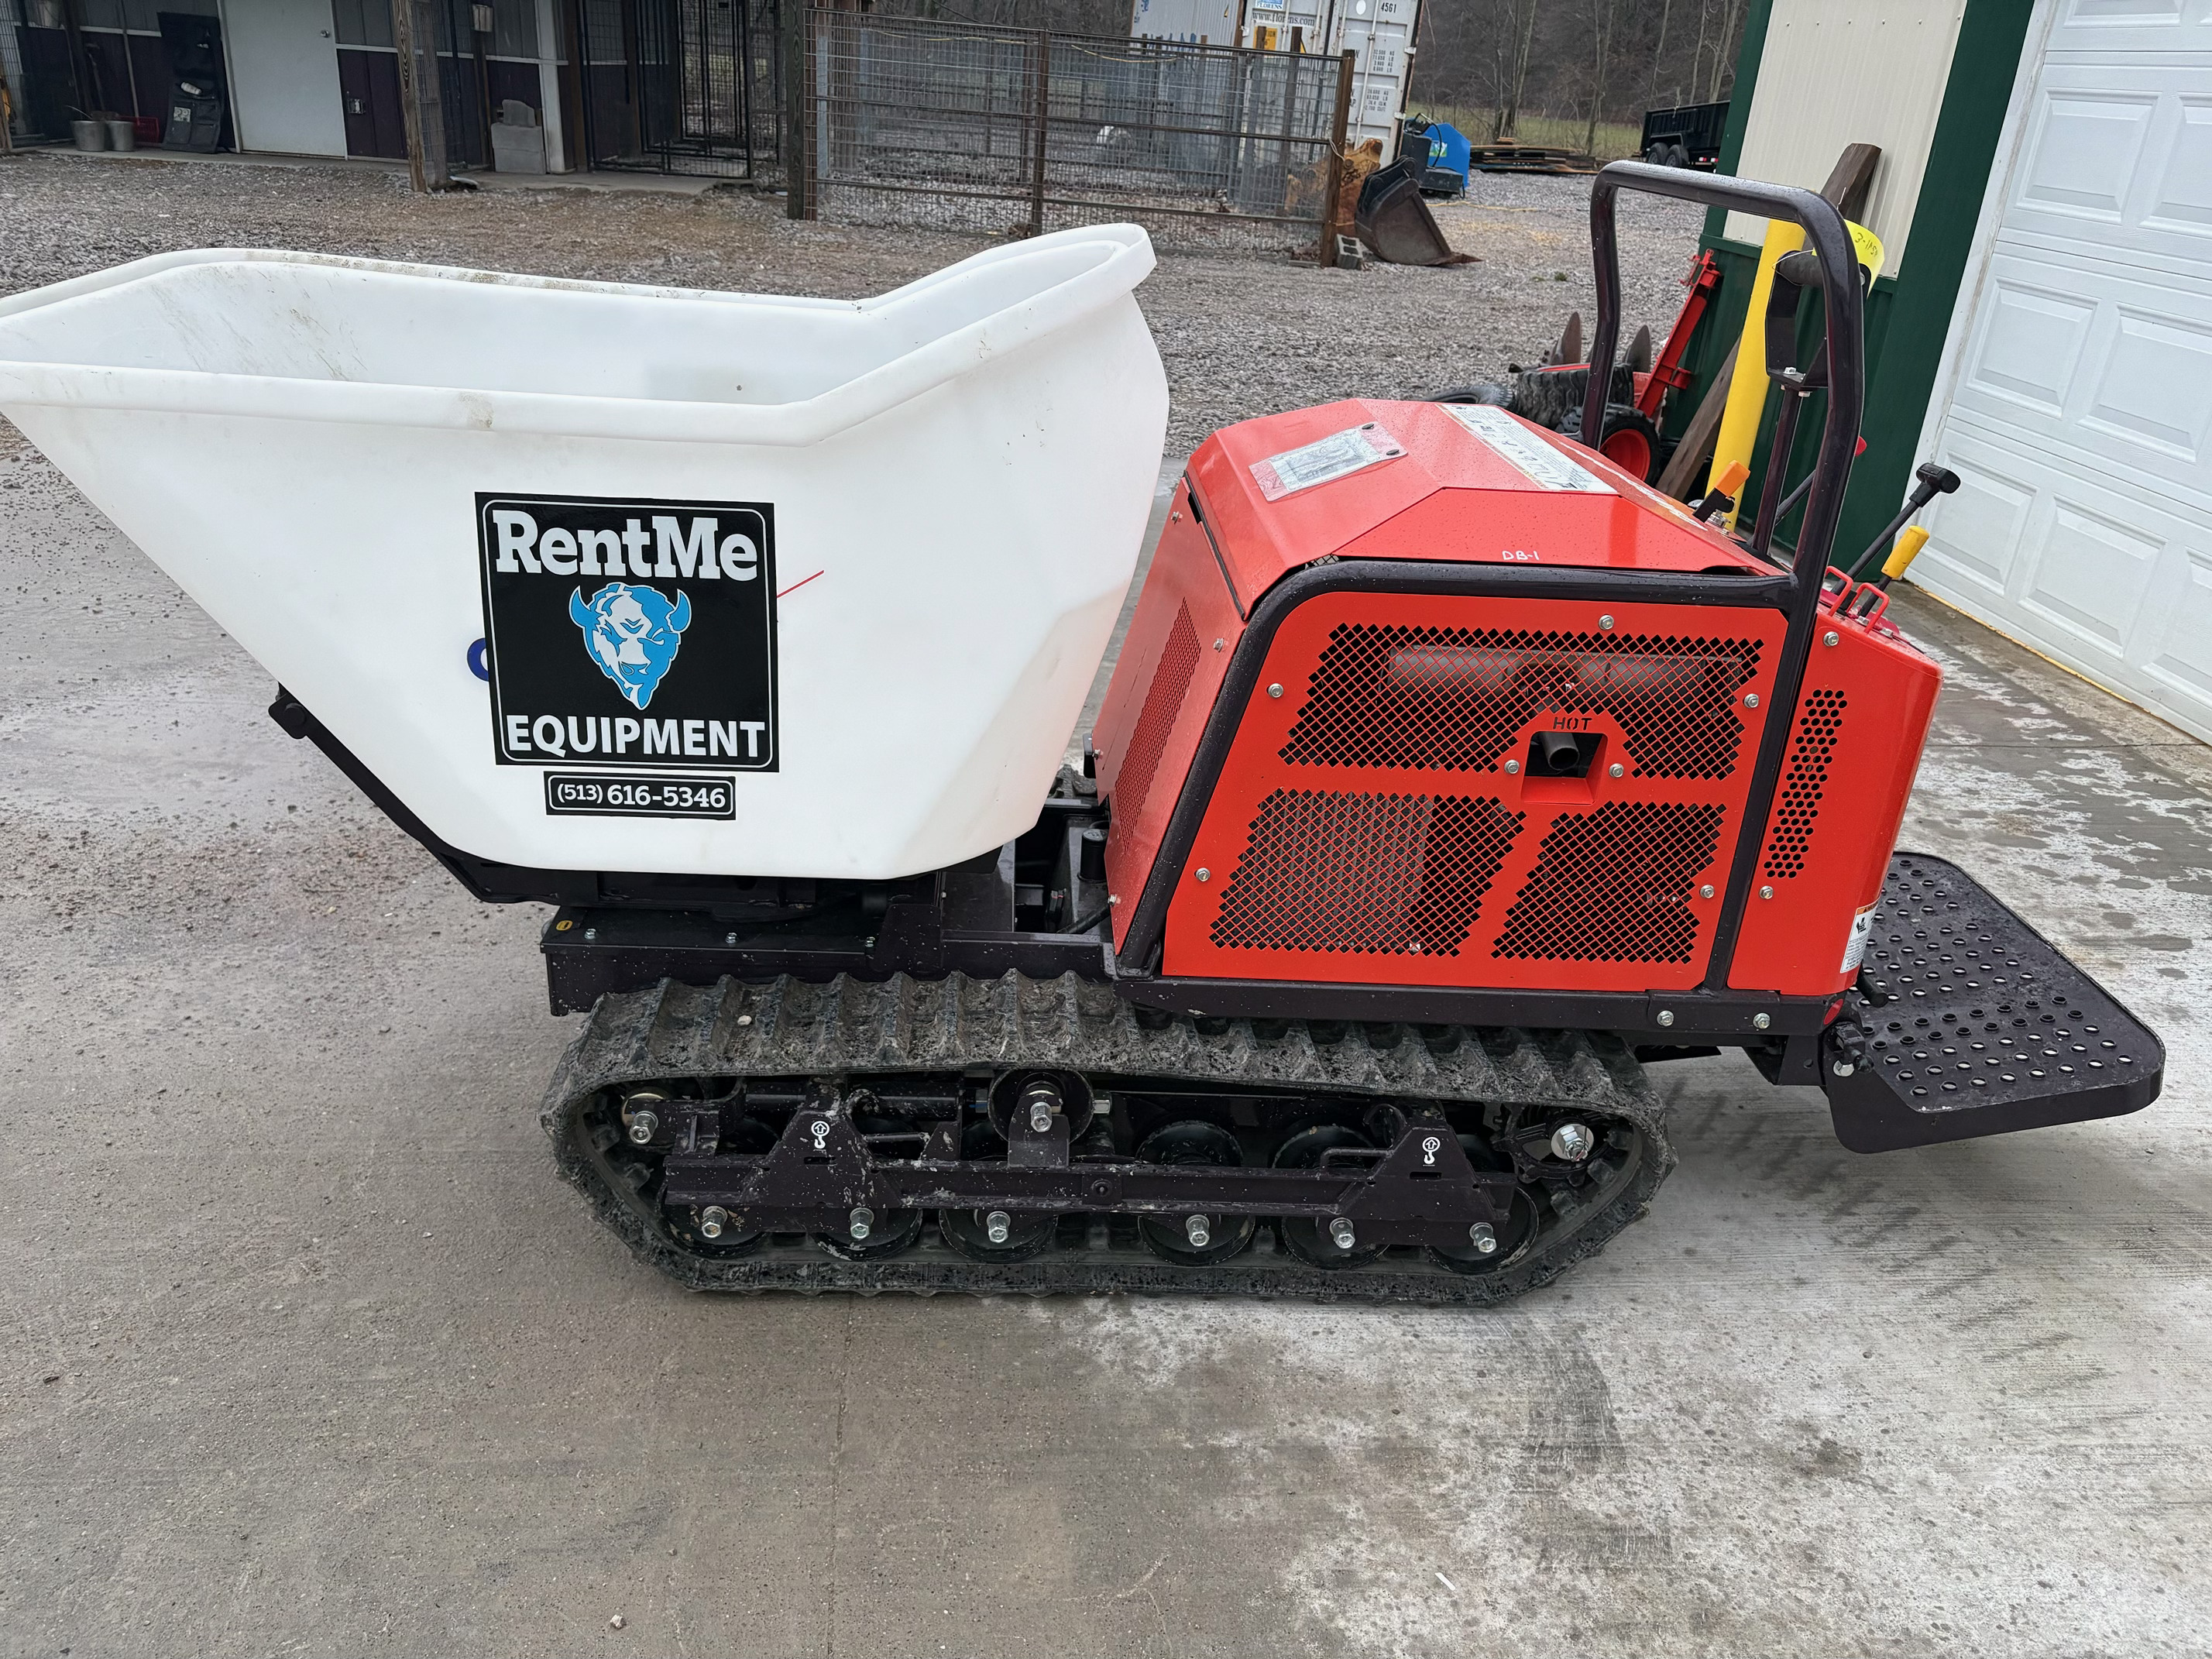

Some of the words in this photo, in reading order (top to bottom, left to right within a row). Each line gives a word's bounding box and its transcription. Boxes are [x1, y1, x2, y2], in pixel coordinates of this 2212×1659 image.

[493, 510, 757, 581] RentMe
[1502, 550, 1540, 560] DB-1
[1553, 716, 1592, 730] HOT
[507, 715, 765, 757] EQUIPMENT
[558, 784, 603, 803] (513)
[607, 785, 726, 808] 616-5346
